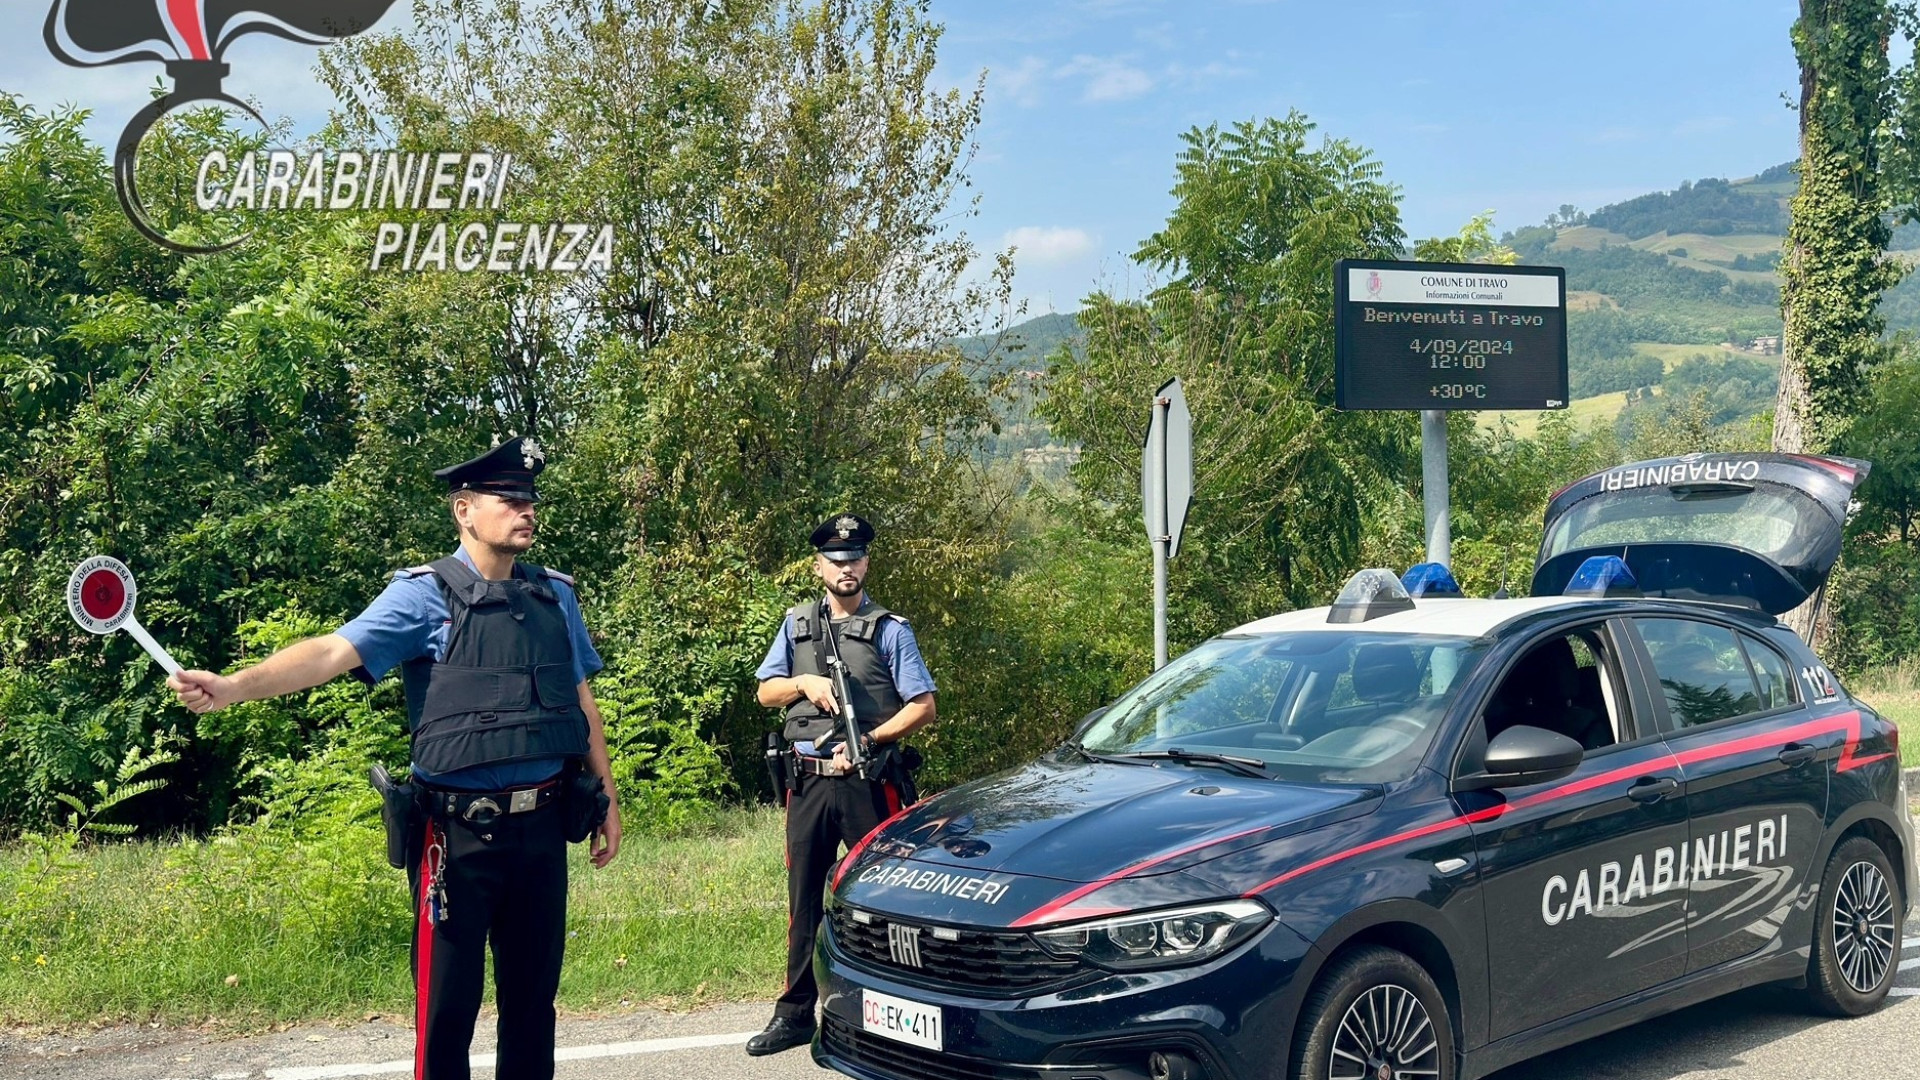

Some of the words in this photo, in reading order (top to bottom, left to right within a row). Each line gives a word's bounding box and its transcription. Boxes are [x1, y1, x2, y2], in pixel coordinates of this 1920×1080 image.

[1421, 277, 1463, 288] COMUNE
[1465, 278, 1476, 288] DI
[1479, 278, 1508, 288] TRAVO
[1425, 290, 1469, 300] Informazioni
[1471, 291, 1503, 301] Comunali
[1364, 307, 1465, 324] Benvenuti
[1472, 313, 1483, 325] a
[1489, 311, 1543, 326] Travo
[1409, 338, 1513, 355] 4/09/2024
[1430, 354, 1486, 369] 12:00
[1429, 384, 1487, 399] +30°C
[1601, 461, 1758, 491] CARABINIERI
[78, 560, 102, 580] DELLA
[104, 560, 129, 582] DIFESA
[72, 581, 94, 627] MINISTERO
[104, 593, 133, 628] CARABINIERI
[1802, 665, 1835, 698] 112
[1541, 814, 1788, 926] CARABINIERI
[858, 865, 1009, 904] CARABINIERI
[888, 923, 923, 967] FIAT
[912, 1012, 937, 1041] 411
